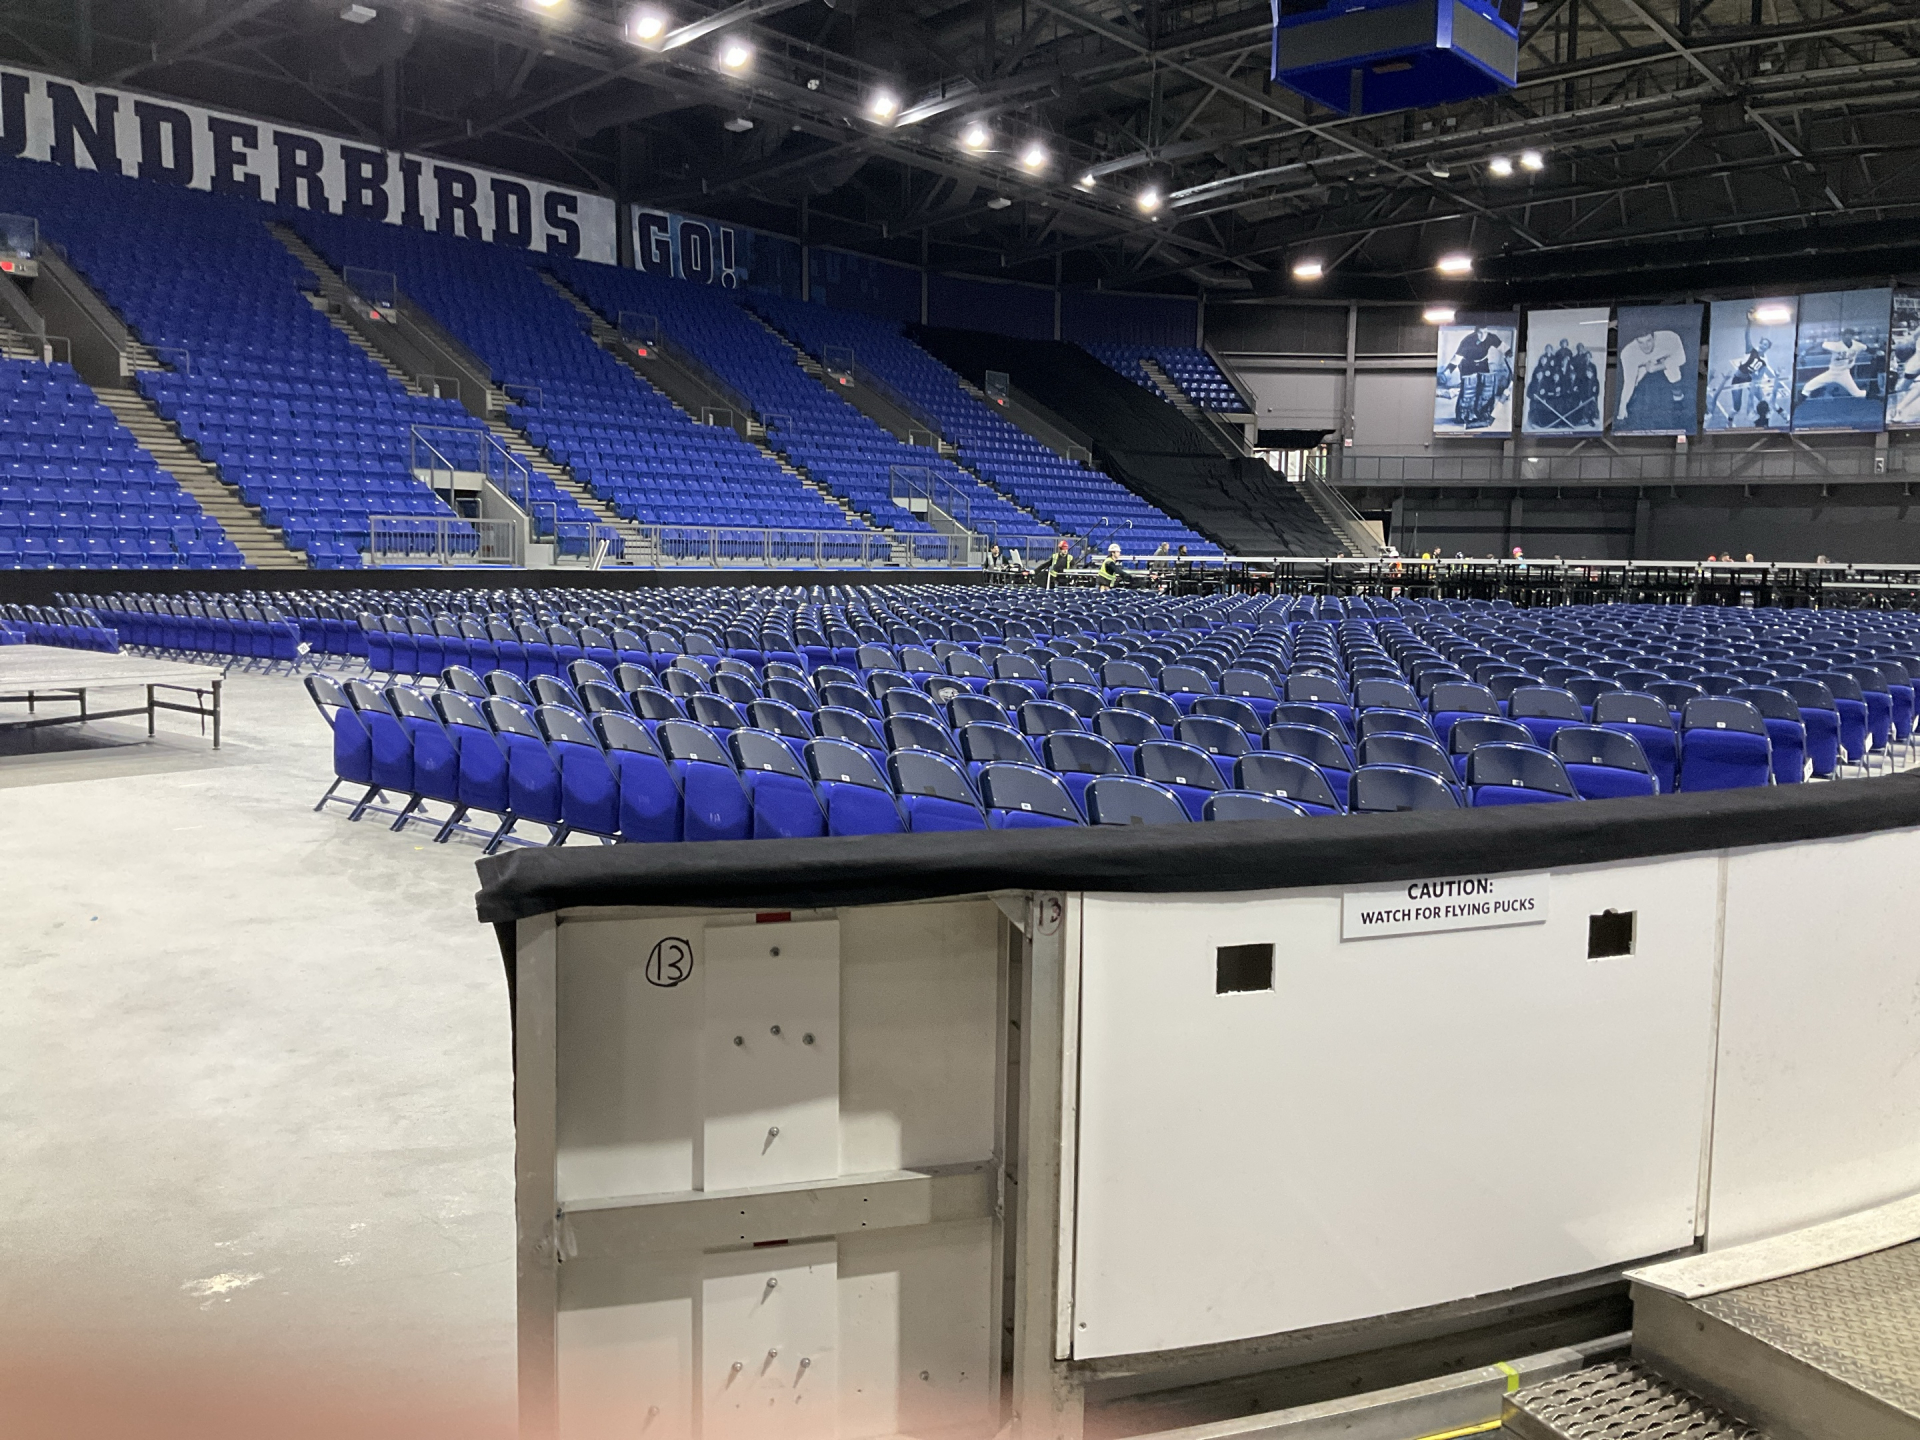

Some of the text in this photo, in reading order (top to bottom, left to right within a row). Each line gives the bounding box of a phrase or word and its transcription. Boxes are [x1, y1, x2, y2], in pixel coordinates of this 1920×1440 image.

[637, 211, 737, 289] GO!
[1749, 357, 1763, 370] 10
[1407, 878, 1494, 900] CAUTION:
[1038, 897, 1062, 926] 13
[1361, 898, 1535, 925] WATCH FOR FLYING PUCKS
